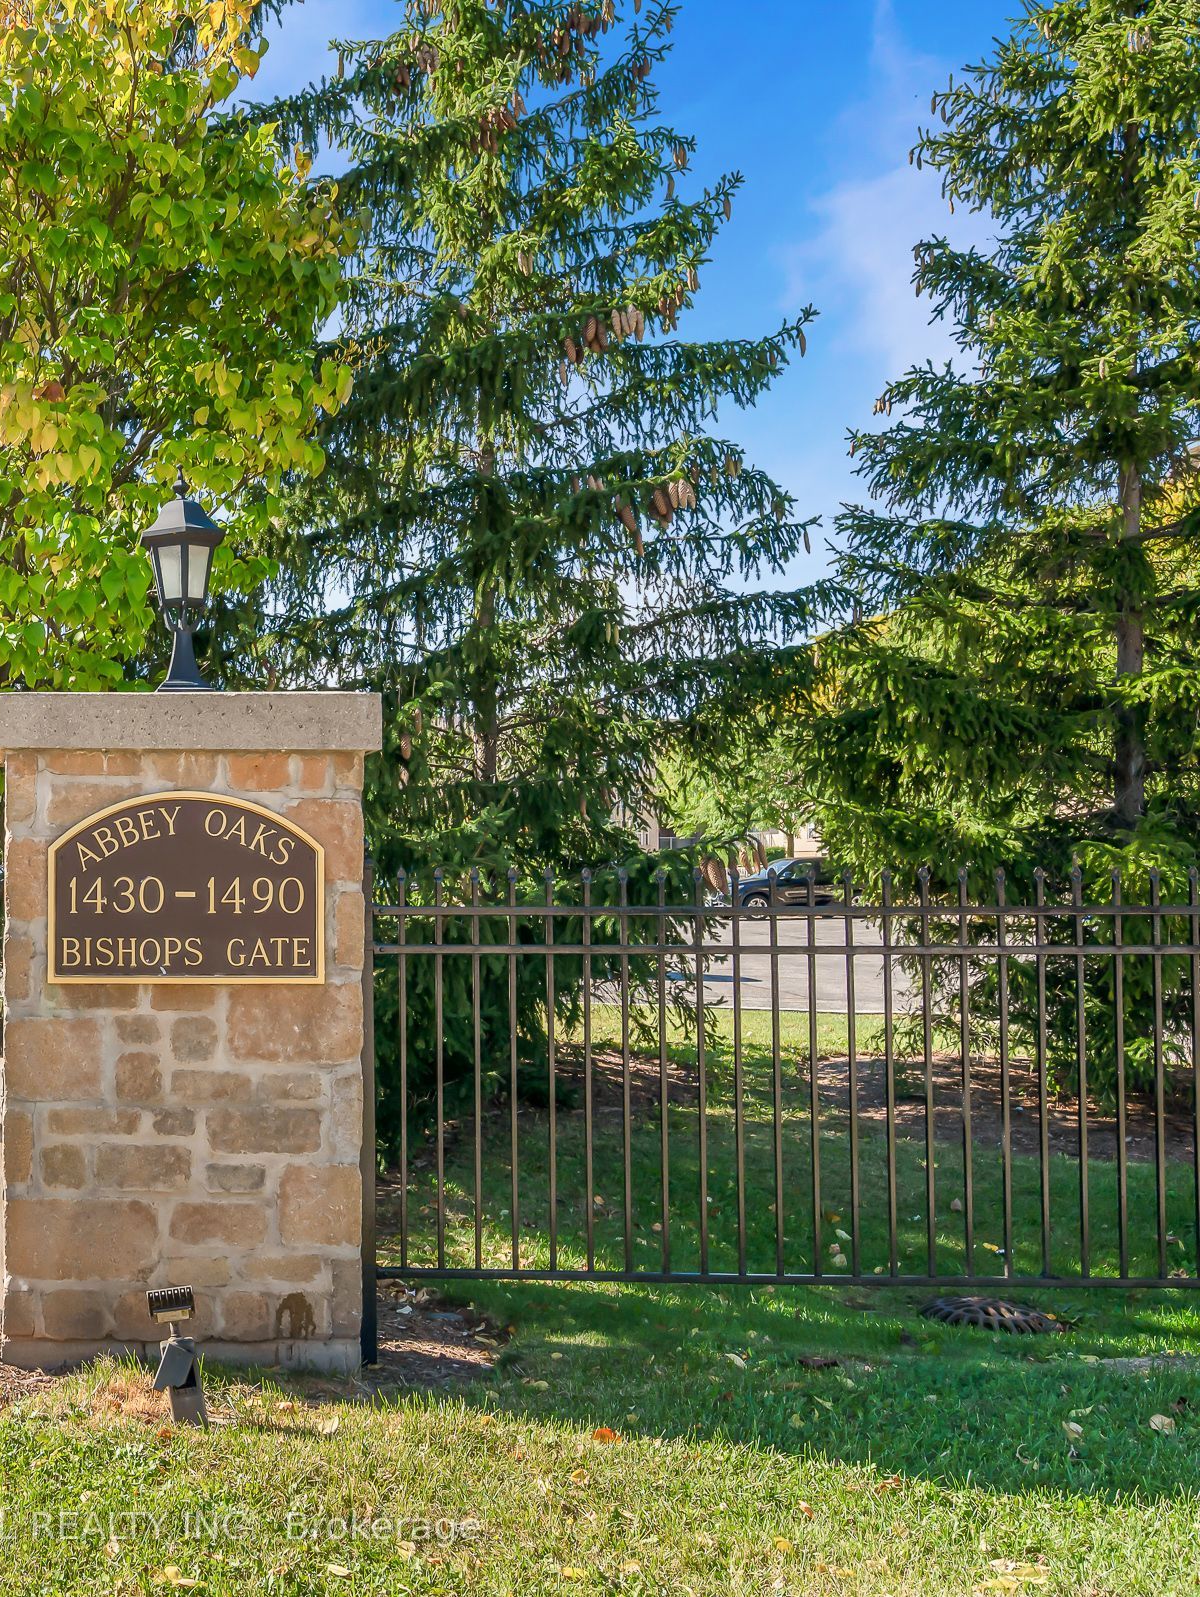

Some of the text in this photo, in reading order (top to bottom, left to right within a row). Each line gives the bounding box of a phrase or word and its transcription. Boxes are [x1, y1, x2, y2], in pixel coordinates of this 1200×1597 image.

[74, 806, 296, 872] ABBEY OAKS
[61, 937, 312, 968] BISHOPS GATE
